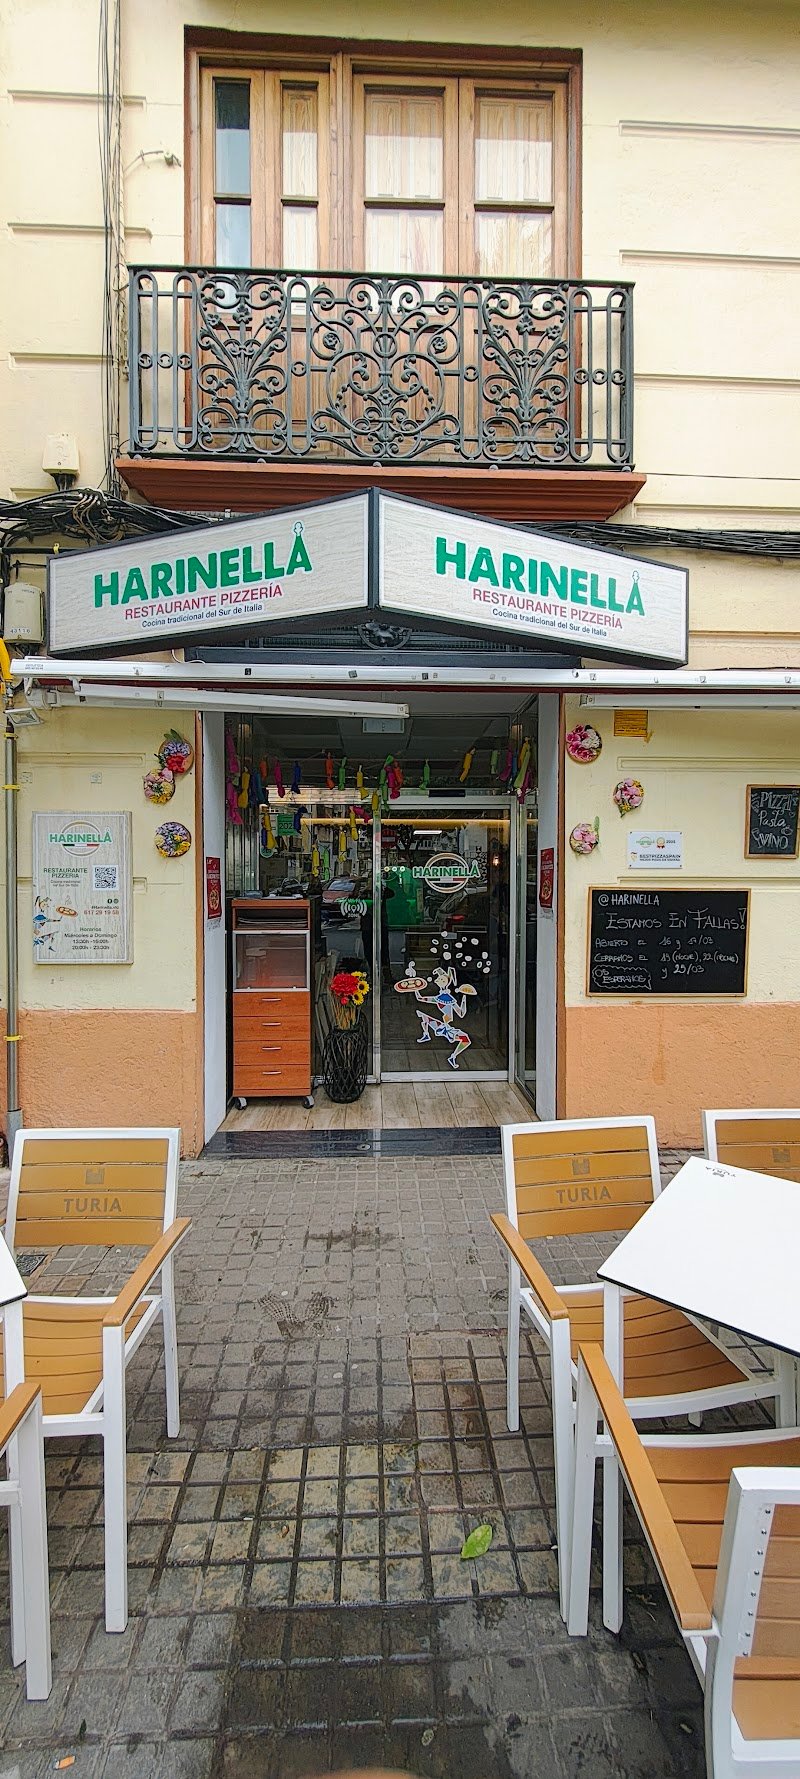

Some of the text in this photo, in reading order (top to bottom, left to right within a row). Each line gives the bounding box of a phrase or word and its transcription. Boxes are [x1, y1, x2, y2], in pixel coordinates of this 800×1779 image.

[94, 534, 312, 608] HARINELLA
[436, 536, 645, 616] HARINELLA
[125, 583, 282, 620] RESTAURANTE PIZZERÍA
[472, 588, 623, 629] RESTAURANTE PIZZERÍA
[141, 603, 263, 628] Cocina tradicional del Sur de Italia
[492, 608, 607, 637] Cocina tradicional del Sur de Italia
[758, 810, 786, 828] Pasta
[49, 831, 112, 843] HARINELLA
[413, 863, 481, 877] HARINELLA
[63, 1197, 122, 1213] TURIA
[556, 1185, 612, 1204] TURIA
